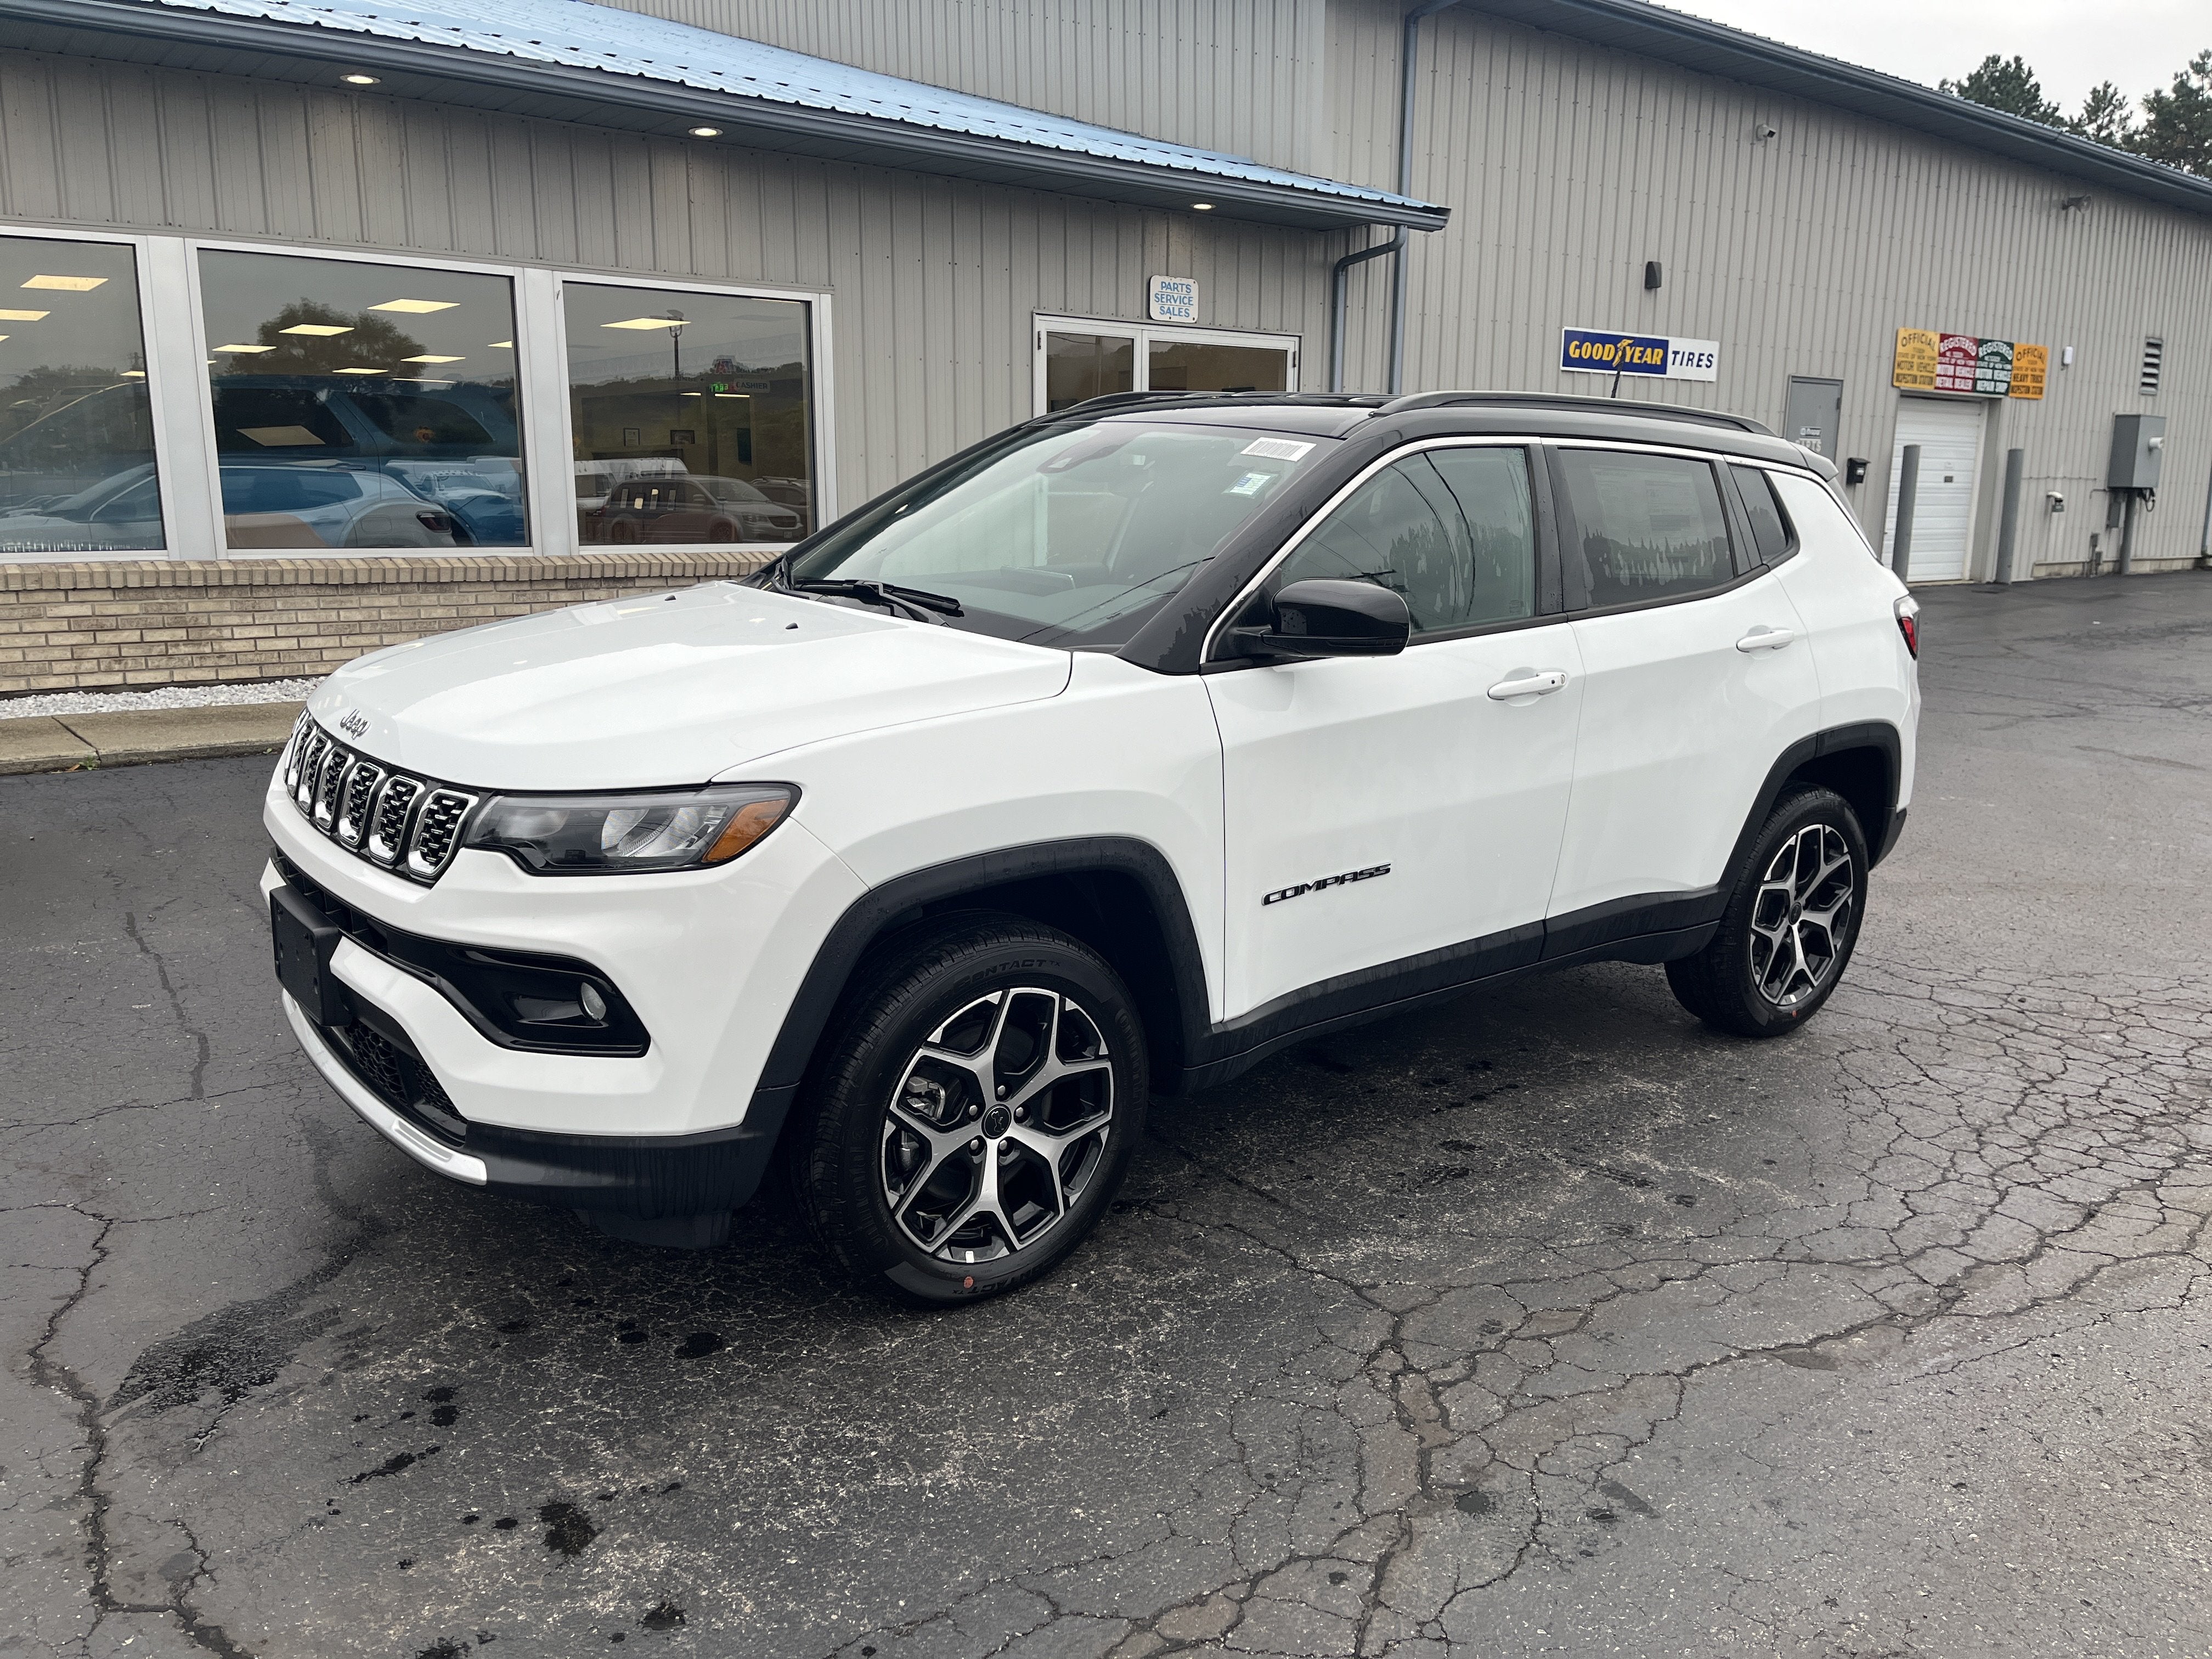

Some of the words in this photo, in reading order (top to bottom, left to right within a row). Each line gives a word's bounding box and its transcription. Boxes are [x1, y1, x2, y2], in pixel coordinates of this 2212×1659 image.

[1161, 281, 1192, 294] PARTS
[1154, 292, 1194, 306] SERVICE
[1159, 306, 1190, 318] SALES
[1900, 333, 1936, 352] OFFICIAL
[1672, 351, 1714, 369] TIRES
[2016, 348, 2045, 365] OFFICIAL
[1897, 360, 1914, 371] MOTOR
[340, 709, 371, 740] Jeep
[1261, 862, 1391, 906] COMPASS
